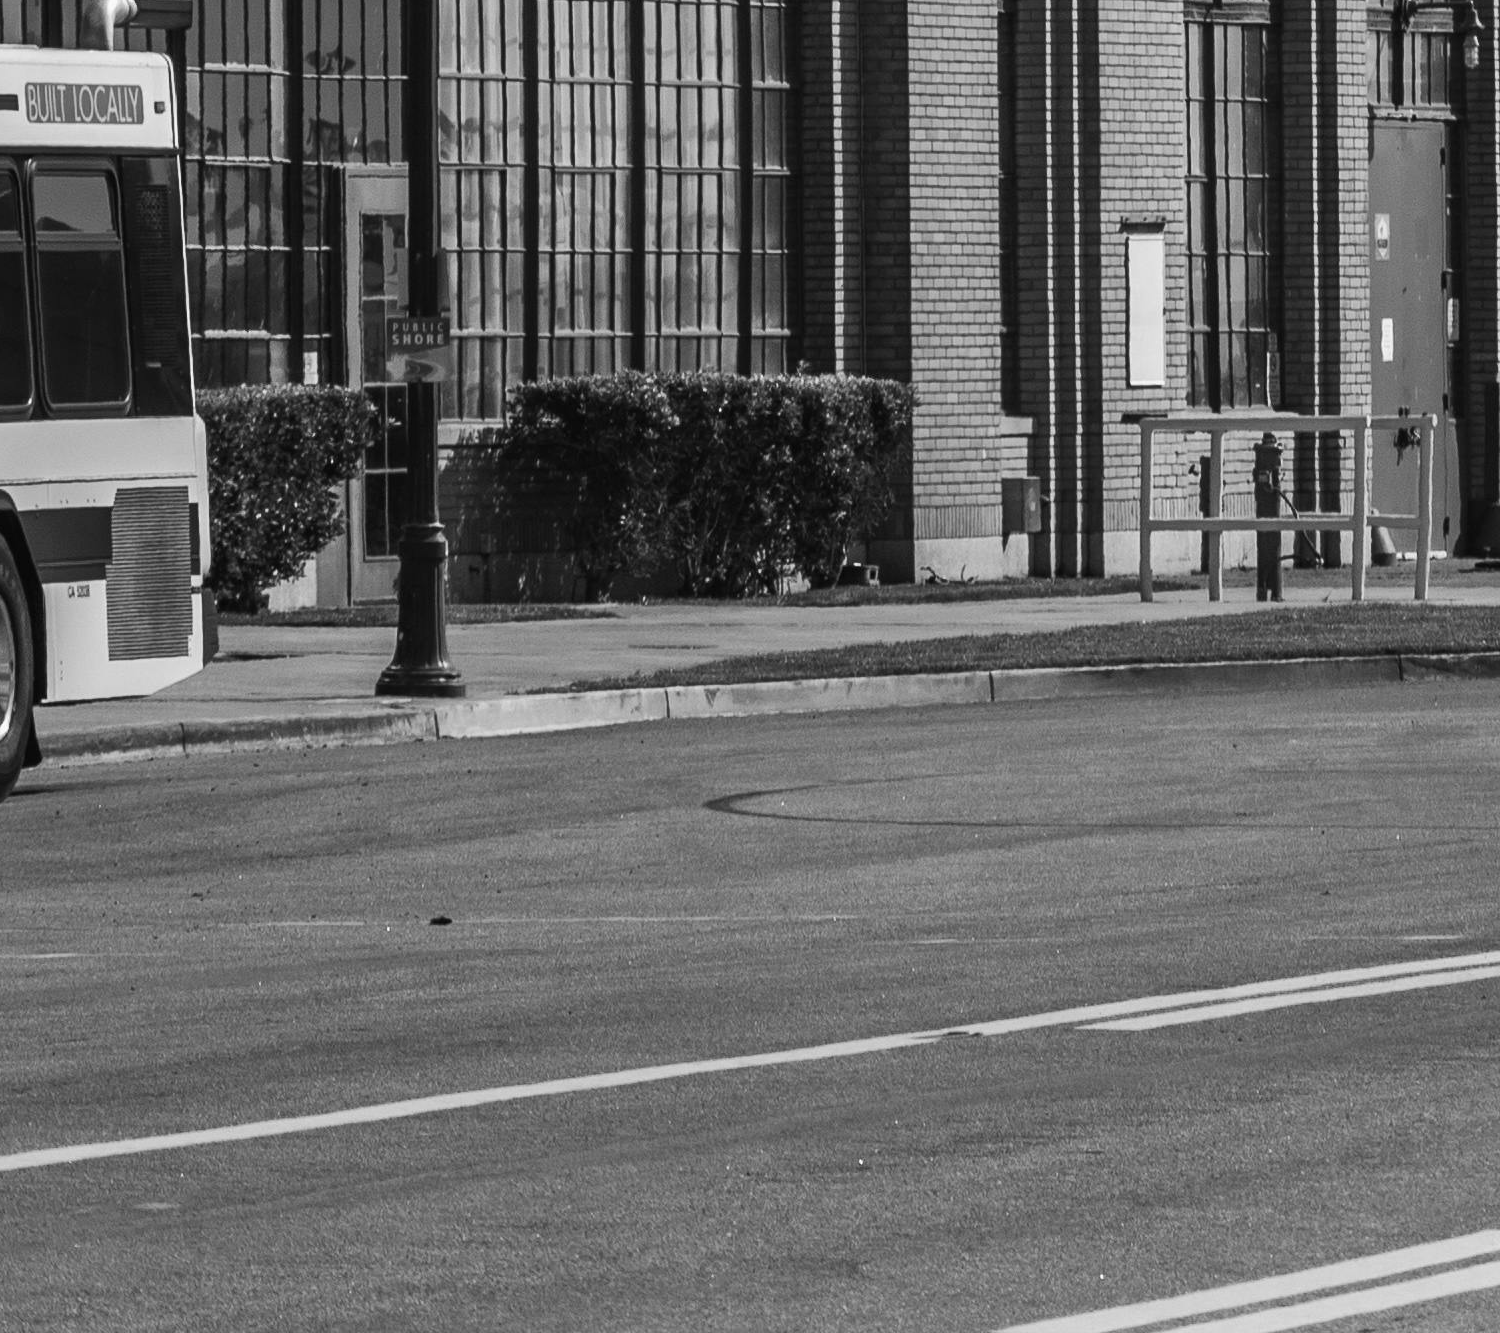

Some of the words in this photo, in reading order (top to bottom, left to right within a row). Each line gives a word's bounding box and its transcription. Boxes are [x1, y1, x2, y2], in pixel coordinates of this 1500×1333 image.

[27, 84, 66, 122] BUILT
[72, 85, 139, 123] LOCALLY
[392, 322, 444, 332] PUBLIC
[391, 334, 444, 345] SHORE
